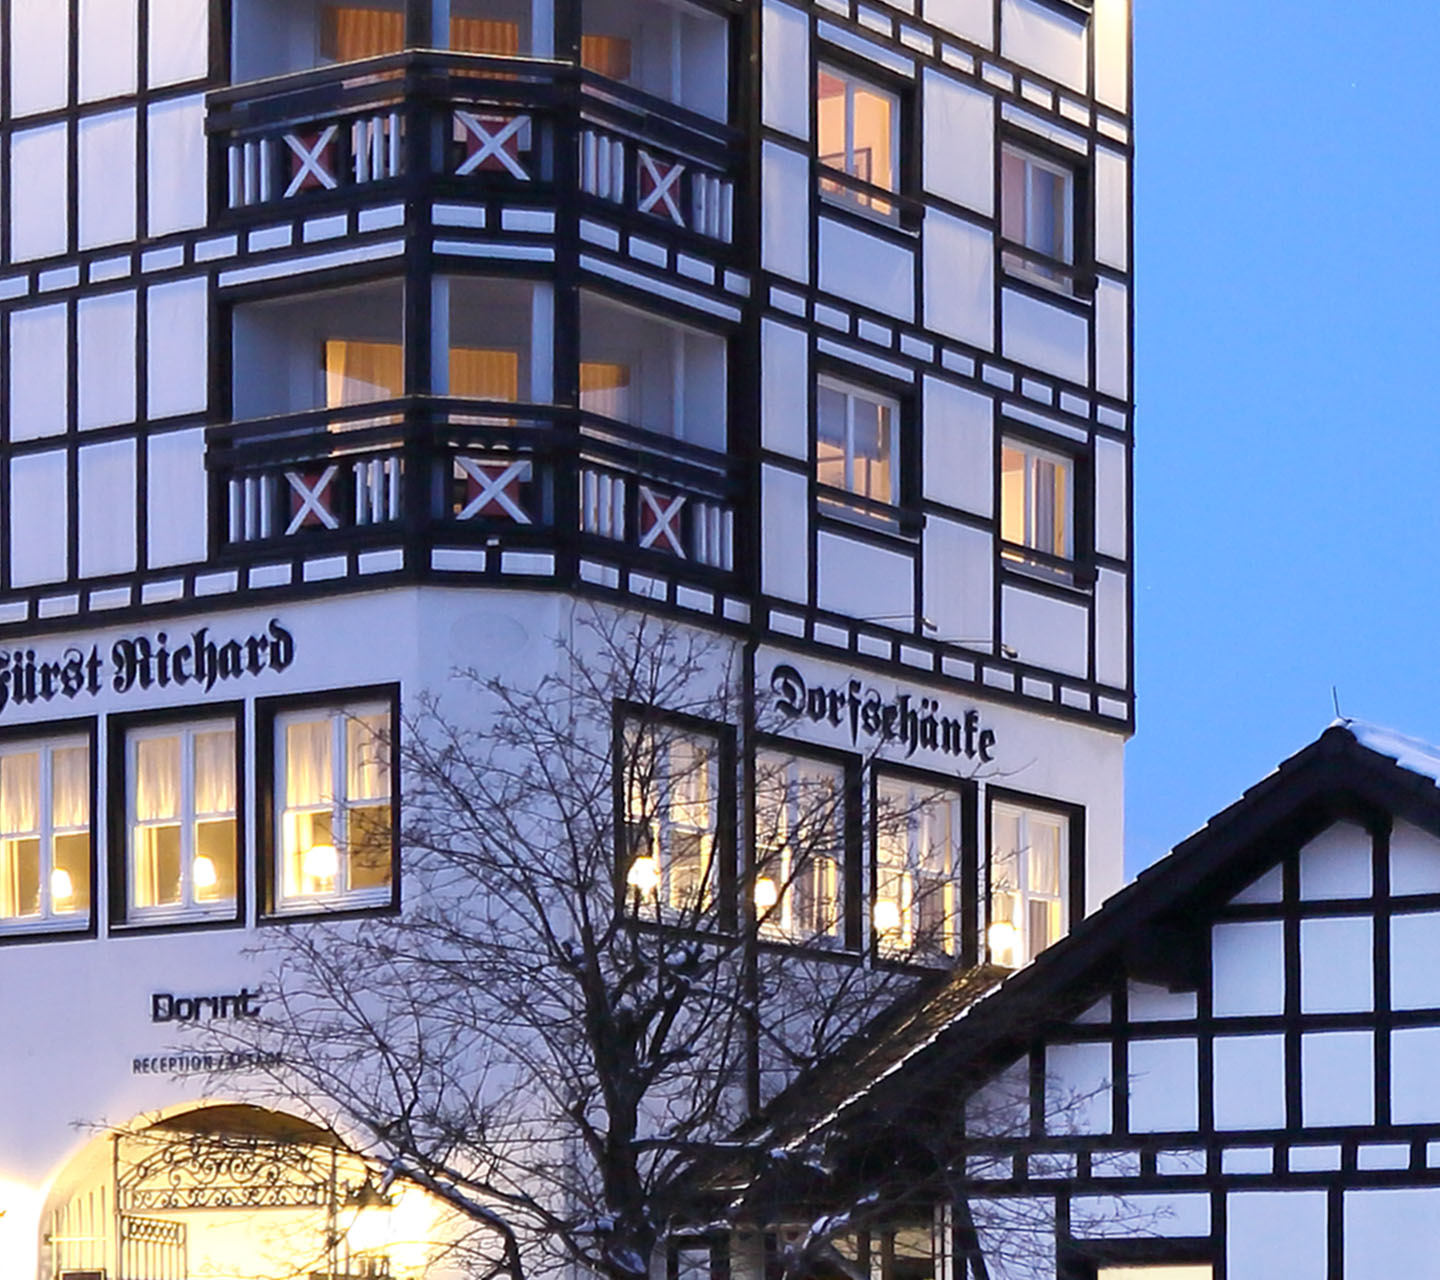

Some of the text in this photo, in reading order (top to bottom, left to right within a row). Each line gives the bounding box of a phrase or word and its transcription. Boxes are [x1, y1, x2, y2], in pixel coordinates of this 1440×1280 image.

[111, 618, 295, 694] Richard
[770, 664, 996, 763] Dorfschänke
[152, 988, 261, 1022] Dorint
[133, 1055, 213, 1074] RECEPTION
